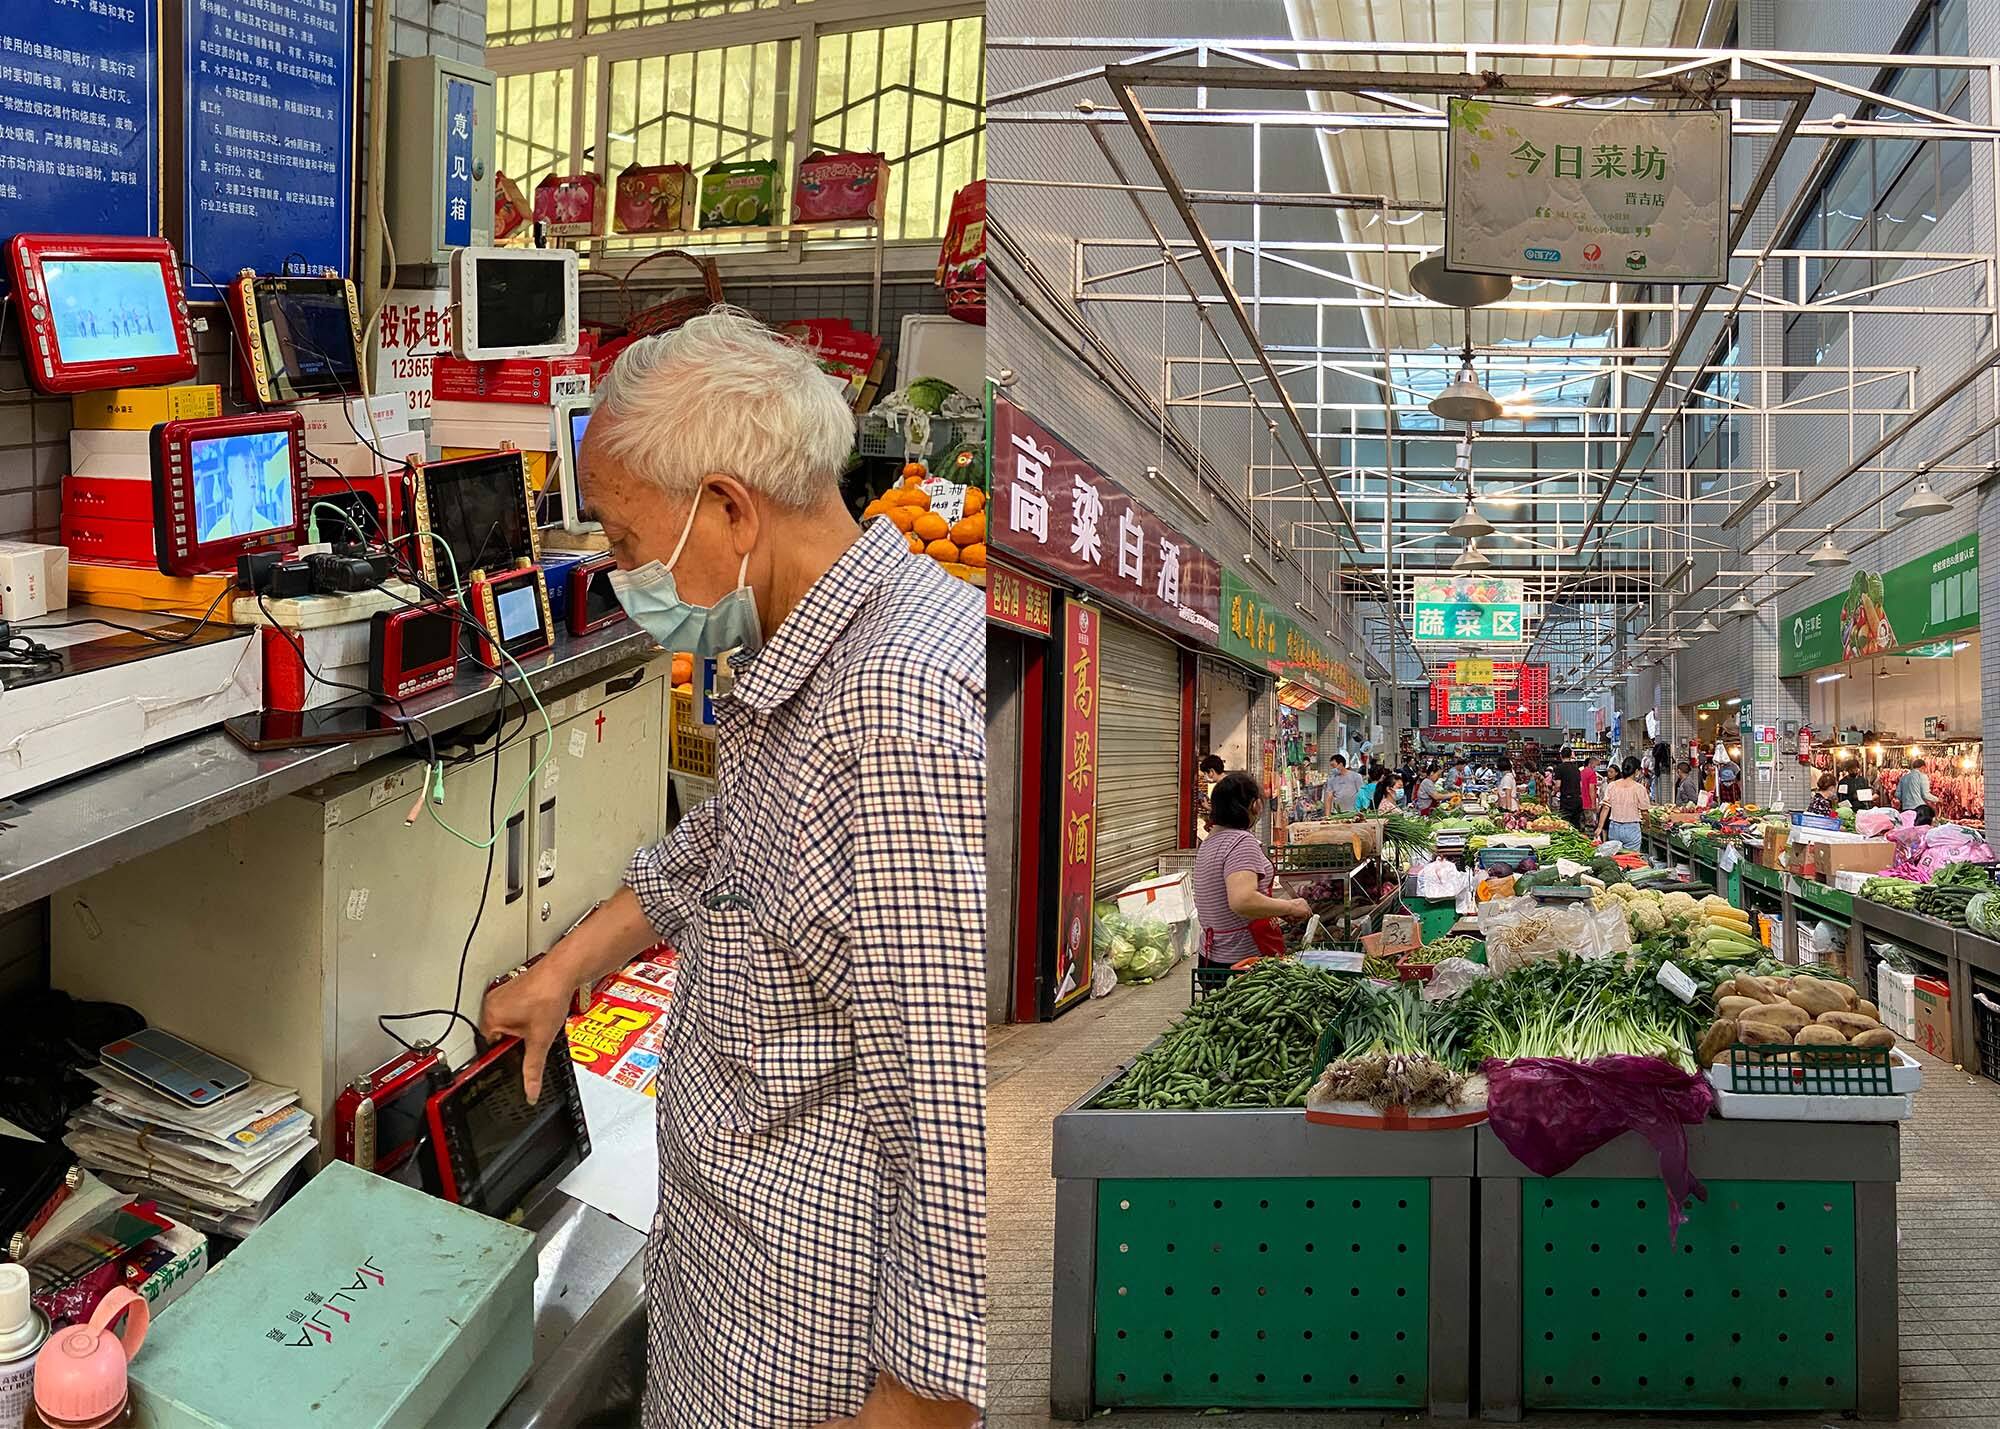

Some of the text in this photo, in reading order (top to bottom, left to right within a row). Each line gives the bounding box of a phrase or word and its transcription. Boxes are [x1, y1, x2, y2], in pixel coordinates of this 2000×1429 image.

[0, 36, 136, 79] 使用的电器和照明灯，要实行定
[0, 66, 131, 104] 时要切断电源，做到人走灯灭。
[450, 112, 469, 222] 意见箱
[1510, 140, 1667, 181] 今日菜坊
[391, 358, 432, 378] 12365
[1010, 433, 1180, 608] 高粱白酒
[1418, 608, 1518, 637] 蔬菜区
[1450, 699, 1493, 712] 蔬菜区
